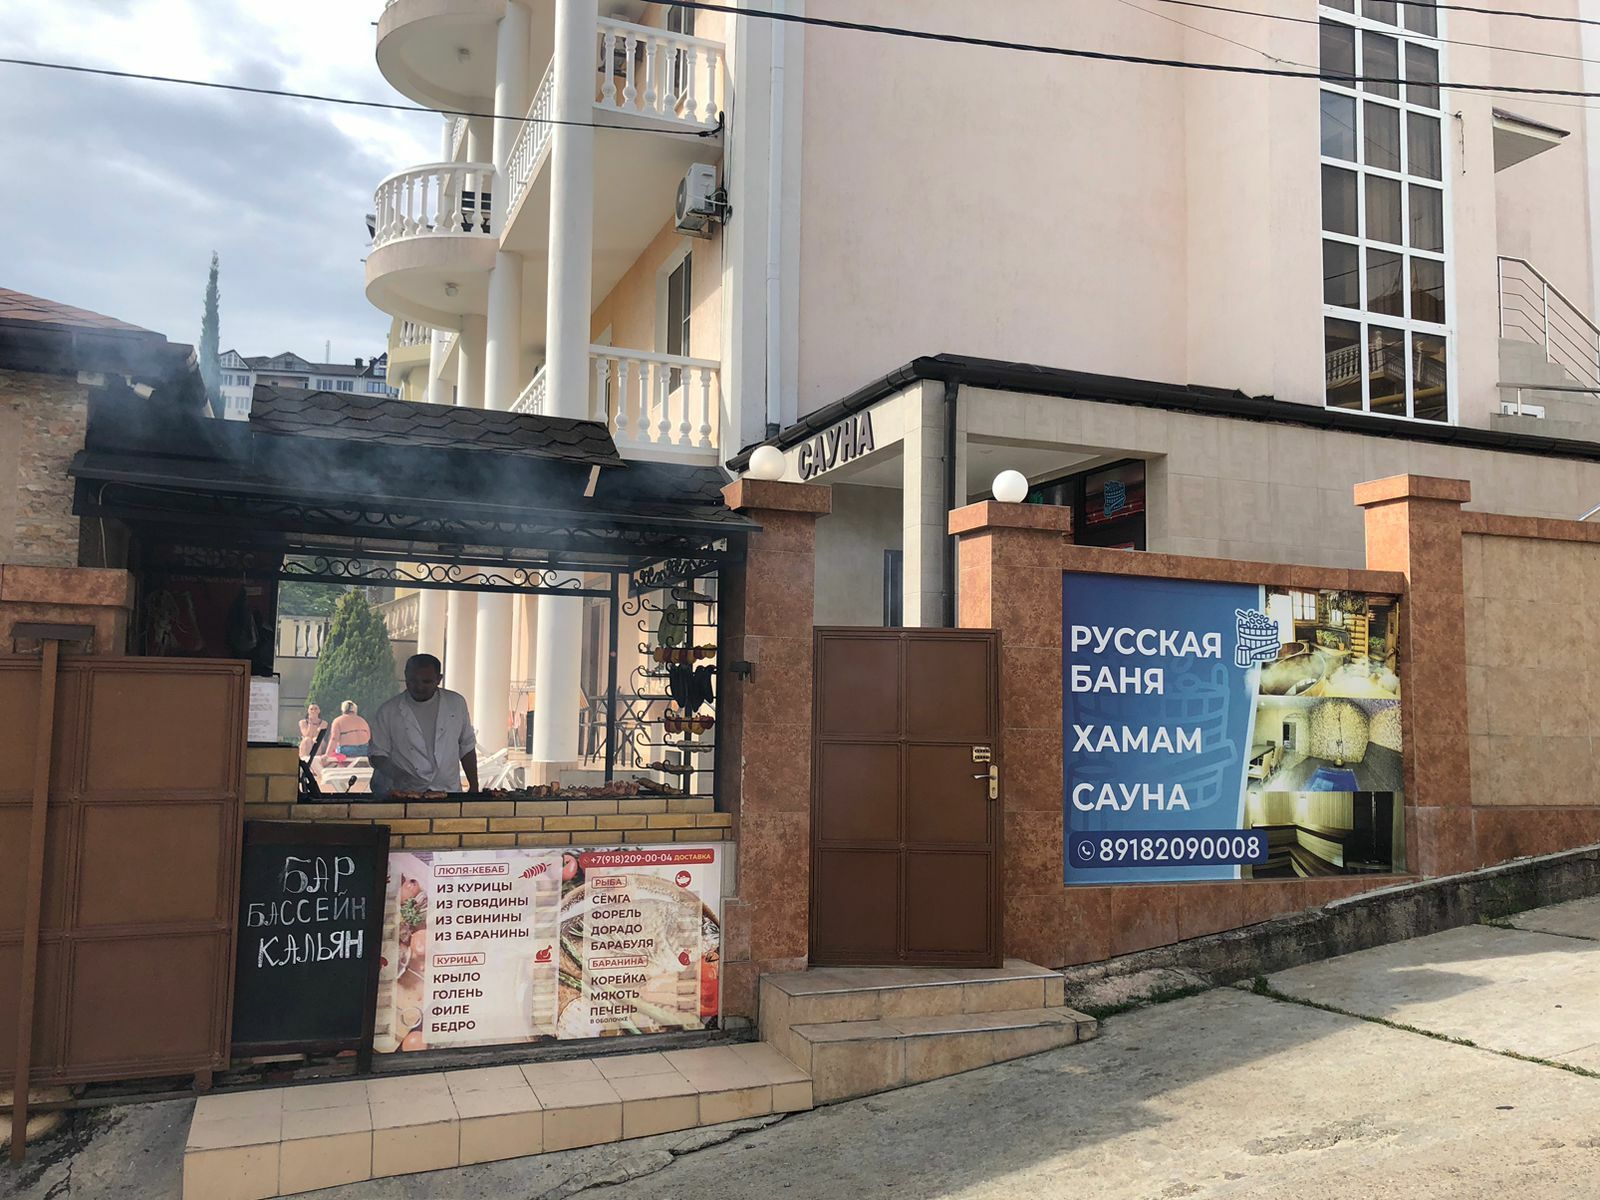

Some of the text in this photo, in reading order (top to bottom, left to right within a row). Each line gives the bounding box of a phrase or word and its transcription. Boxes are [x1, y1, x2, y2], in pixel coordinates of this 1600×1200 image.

[798, 411, 874, 480] САУНА
[1071, 625, 1222, 658] РУССКАЯ
[1071, 665, 1164, 695] БАНЯ
[1073, 724, 1202, 754] ХАМАМ
[1072, 783, 1190, 811] САУНА
[1099, 836, 1260, 861] 89182090008
[591, 853, 711, 865] +7(918)209-00-04 ДОСТАВКА
[283, 856, 355, 893] БАР
[437, 865, 505, 876] ЛЮЛЯ-КЕБАБ
[437, 881, 513, 894] ИЗ КУРИЦЫ
[436, 897, 529, 910] ИЗ ГОВЯДИНЫ
[592, 893, 630, 904] СЁМГА
[247, 889, 366, 927] БАССЕЙН
[435, 913, 522, 925] ИЗ СВИНИНЫ
[592, 909, 641, 920] ФОРЕЛЬ
[435, 928, 529, 941] ИЗ БАРАНИНЫ
[591, 924, 642, 936] ДОРАДО
[258, 930, 364, 968] КАЛЬЯН
[591, 939, 653, 951] БАРАБУЛЯ
[437, 955, 478, 965] КУРИЦА
[592, 959, 644, 968] БАРАНИНА
[433, 972, 481, 984] КРЫЛО
[591, 973, 647, 985] КОРЕЙКА
[432, 988, 483, 1000] ГОЛЕНЬ
[591, 990, 639, 1001] МЯКОТЬ
[432, 1004, 470, 1017] ФИЛЕ
[590, 1005, 638, 1016] ПЕЧЕНЬ
[431, 1020, 475, 1033] БЕДРО
